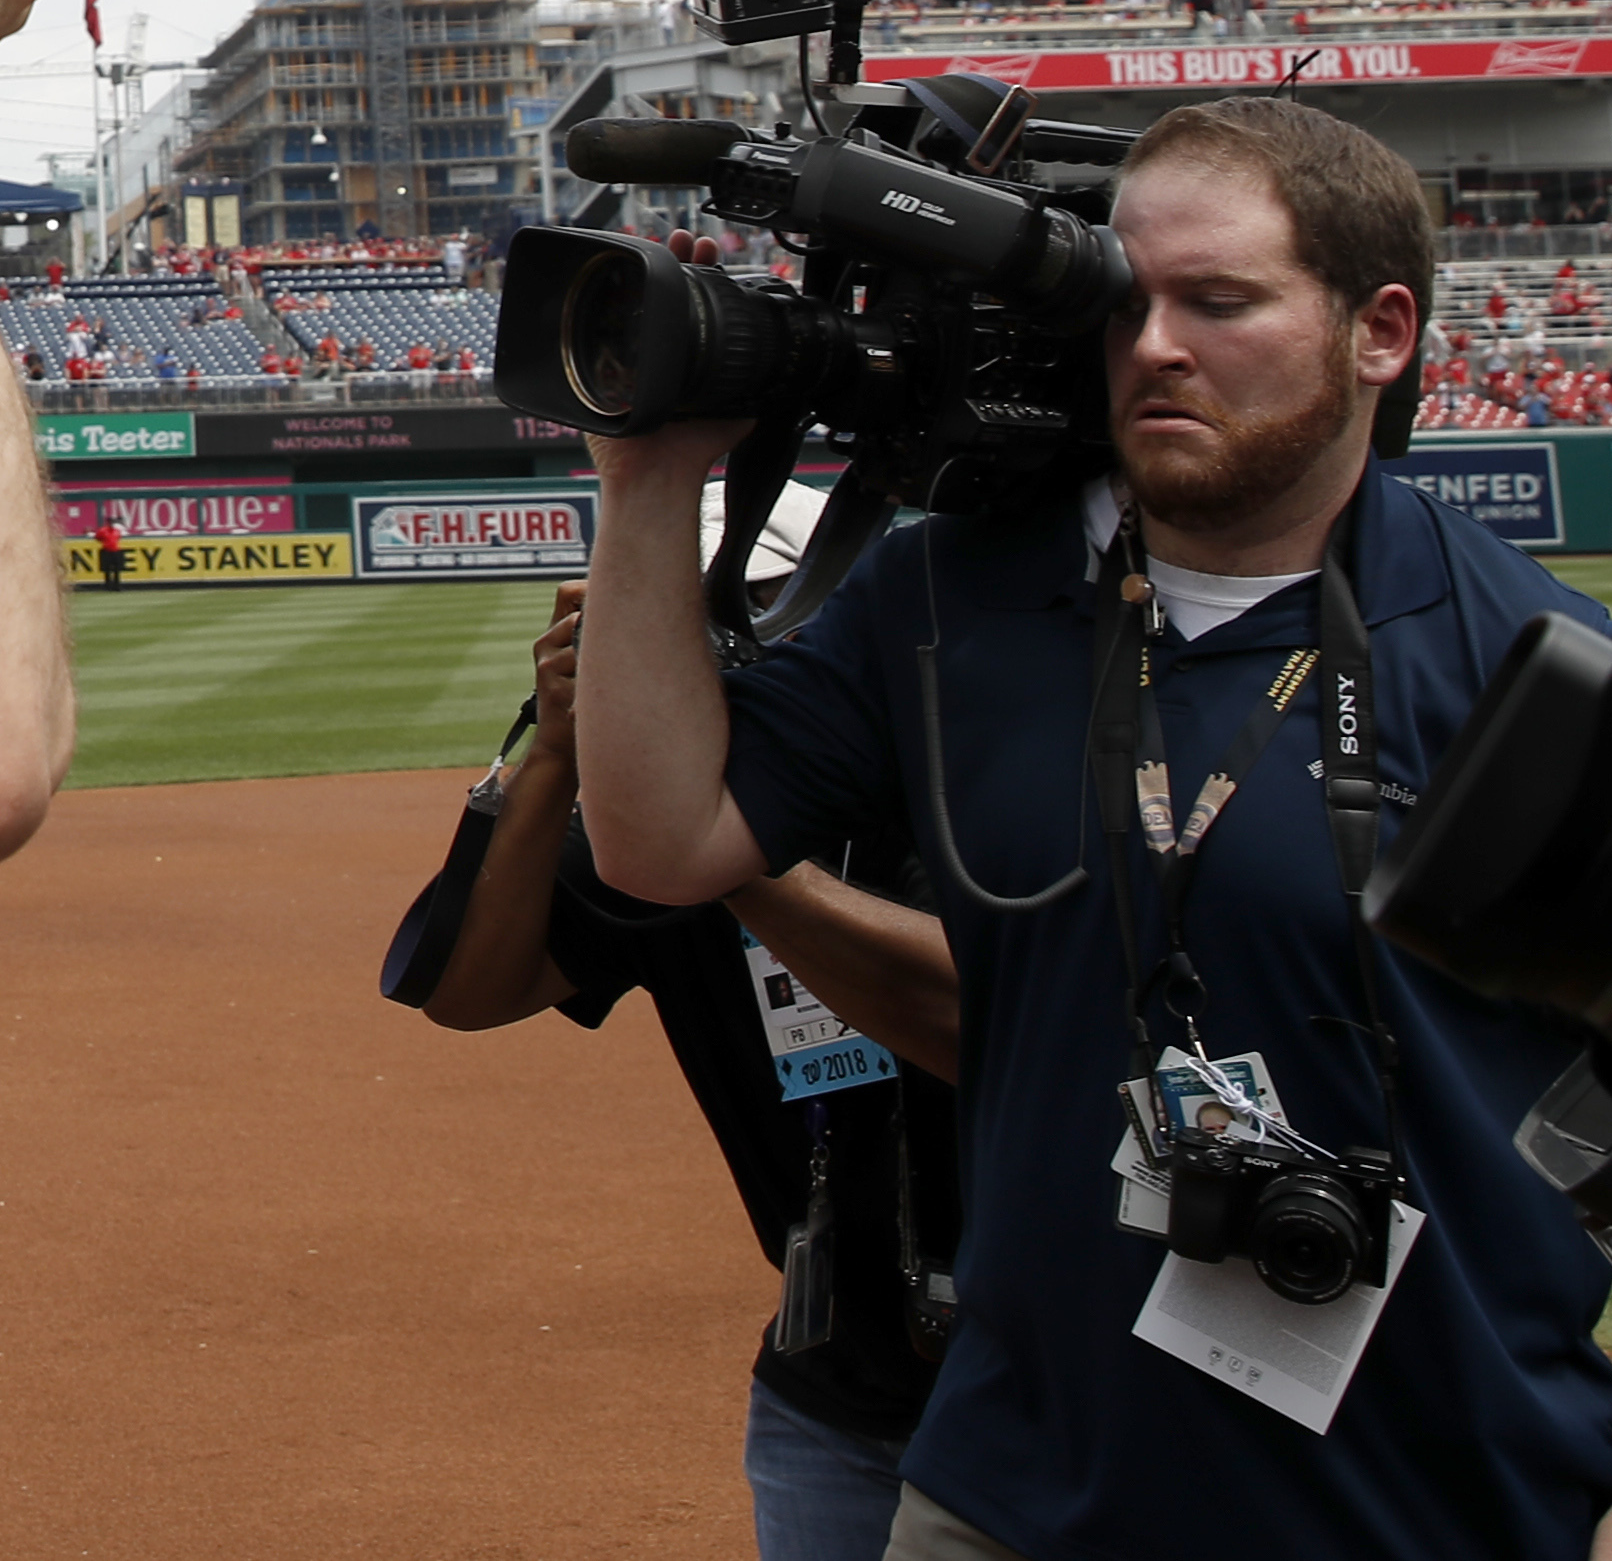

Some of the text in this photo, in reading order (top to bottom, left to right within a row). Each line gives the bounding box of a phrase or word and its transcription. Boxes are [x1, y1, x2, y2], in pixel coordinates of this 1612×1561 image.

[1106, 44, 1421, 84] THIS BUD'S FOR YOU.
[880, 189, 921, 214] HD
[284, 415, 394, 432] WELCOME TO
[81, 425, 187, 453] Teeter
[272, 433, 412, 451] NATIONALS PARK
[178, 543, 336, 570] STANLEY
[1337, 673, 1359, 756] SONY
[823, 1048, 868, 1081] 2018
[1242, 1156, 1281, 1170] SONY
